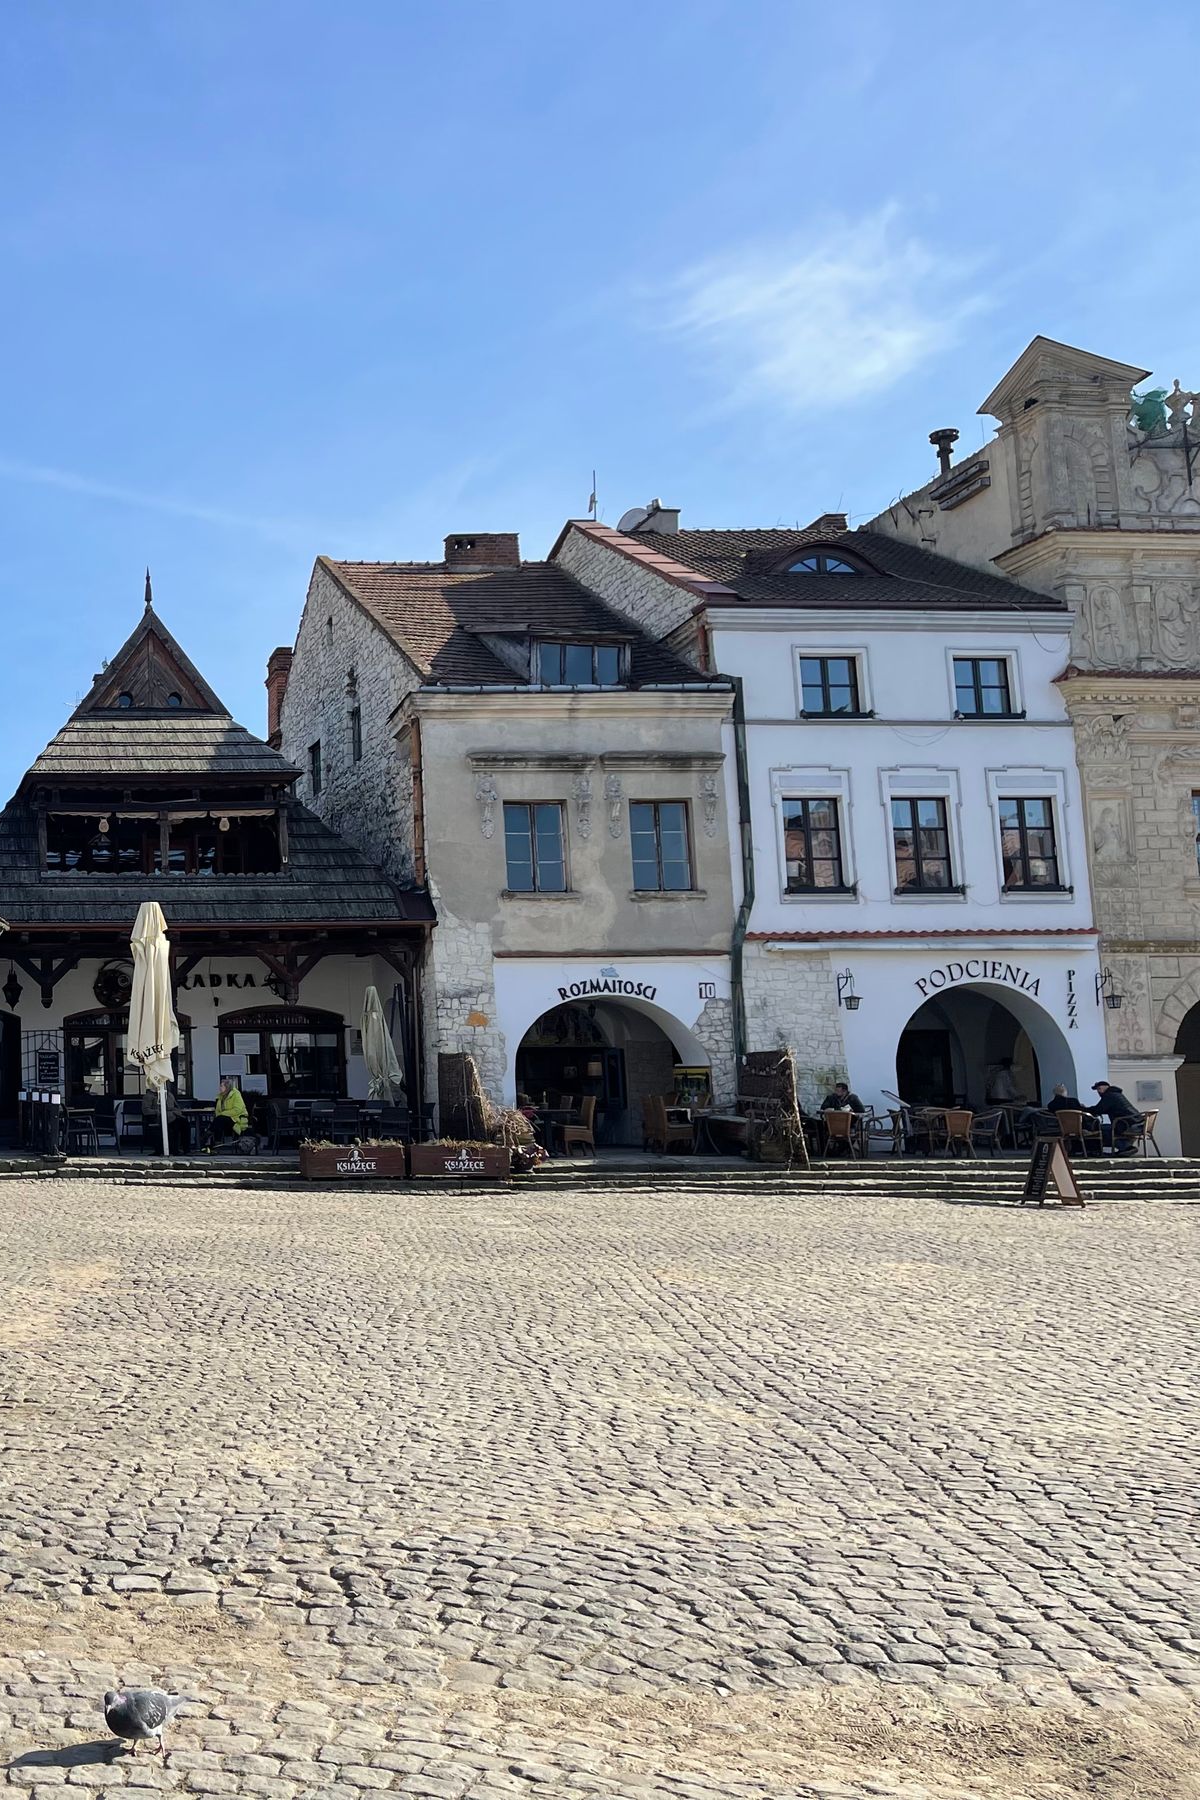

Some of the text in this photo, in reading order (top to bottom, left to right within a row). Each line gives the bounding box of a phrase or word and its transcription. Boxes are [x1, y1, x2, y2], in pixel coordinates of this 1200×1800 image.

[914, 960, 1041, 997] PODCIENIA
[699, 983, 716, 998] 10
[1067, 970, 1079, 1029] PIZZA
[337, 1160, 377, 1172] KSIĄŻĘCE
[445, 1159, 485, 1171] KSIĄŻĘCE
